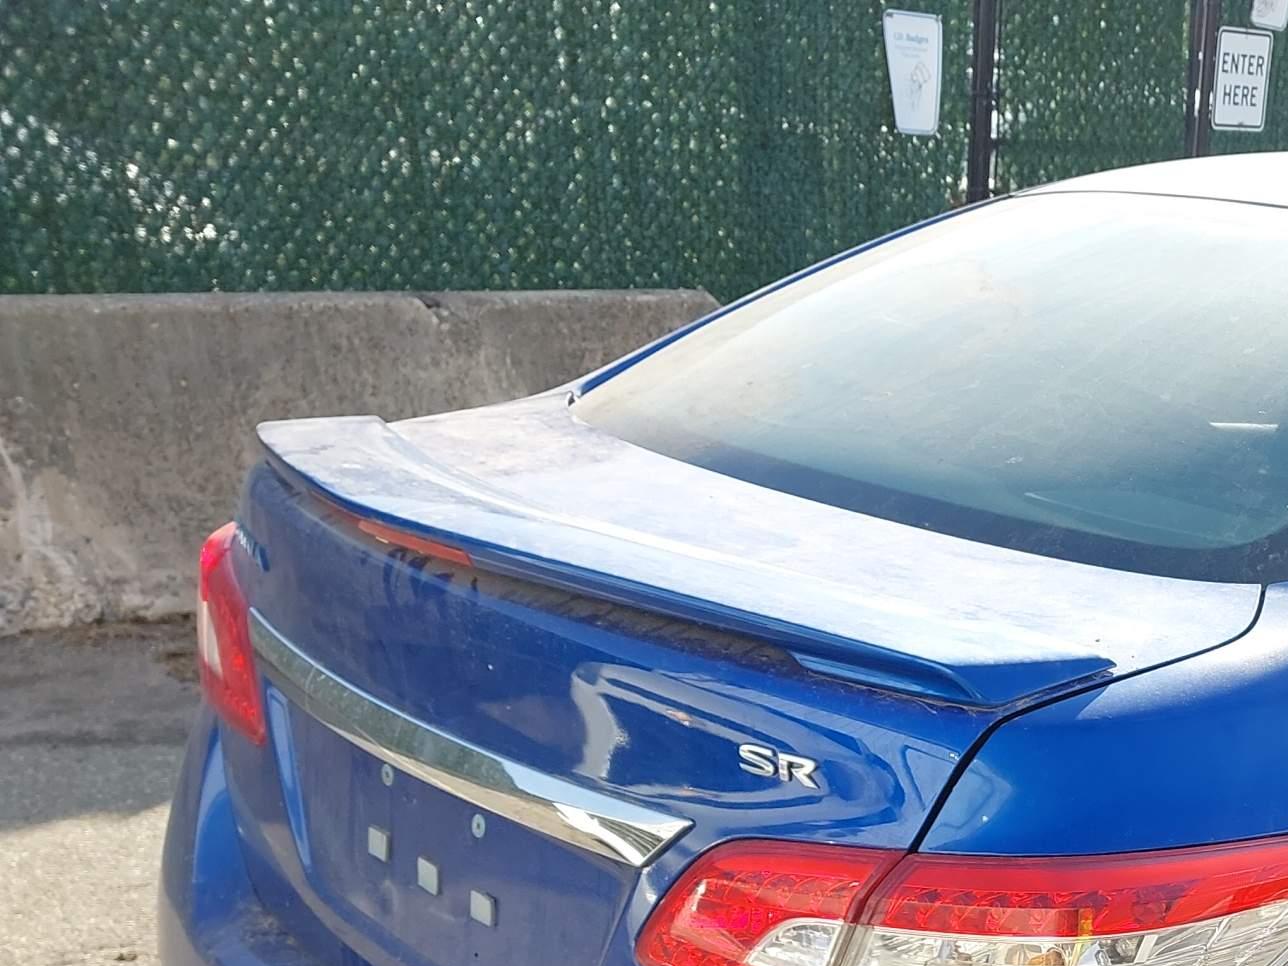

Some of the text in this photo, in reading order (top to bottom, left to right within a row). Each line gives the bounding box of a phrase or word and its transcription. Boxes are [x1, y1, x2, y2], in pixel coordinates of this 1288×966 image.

[1221, 52, 1265, 77] ENTER
[1222, 84, 1258, 107] HERE
[738, 742, 820, 789] SR
